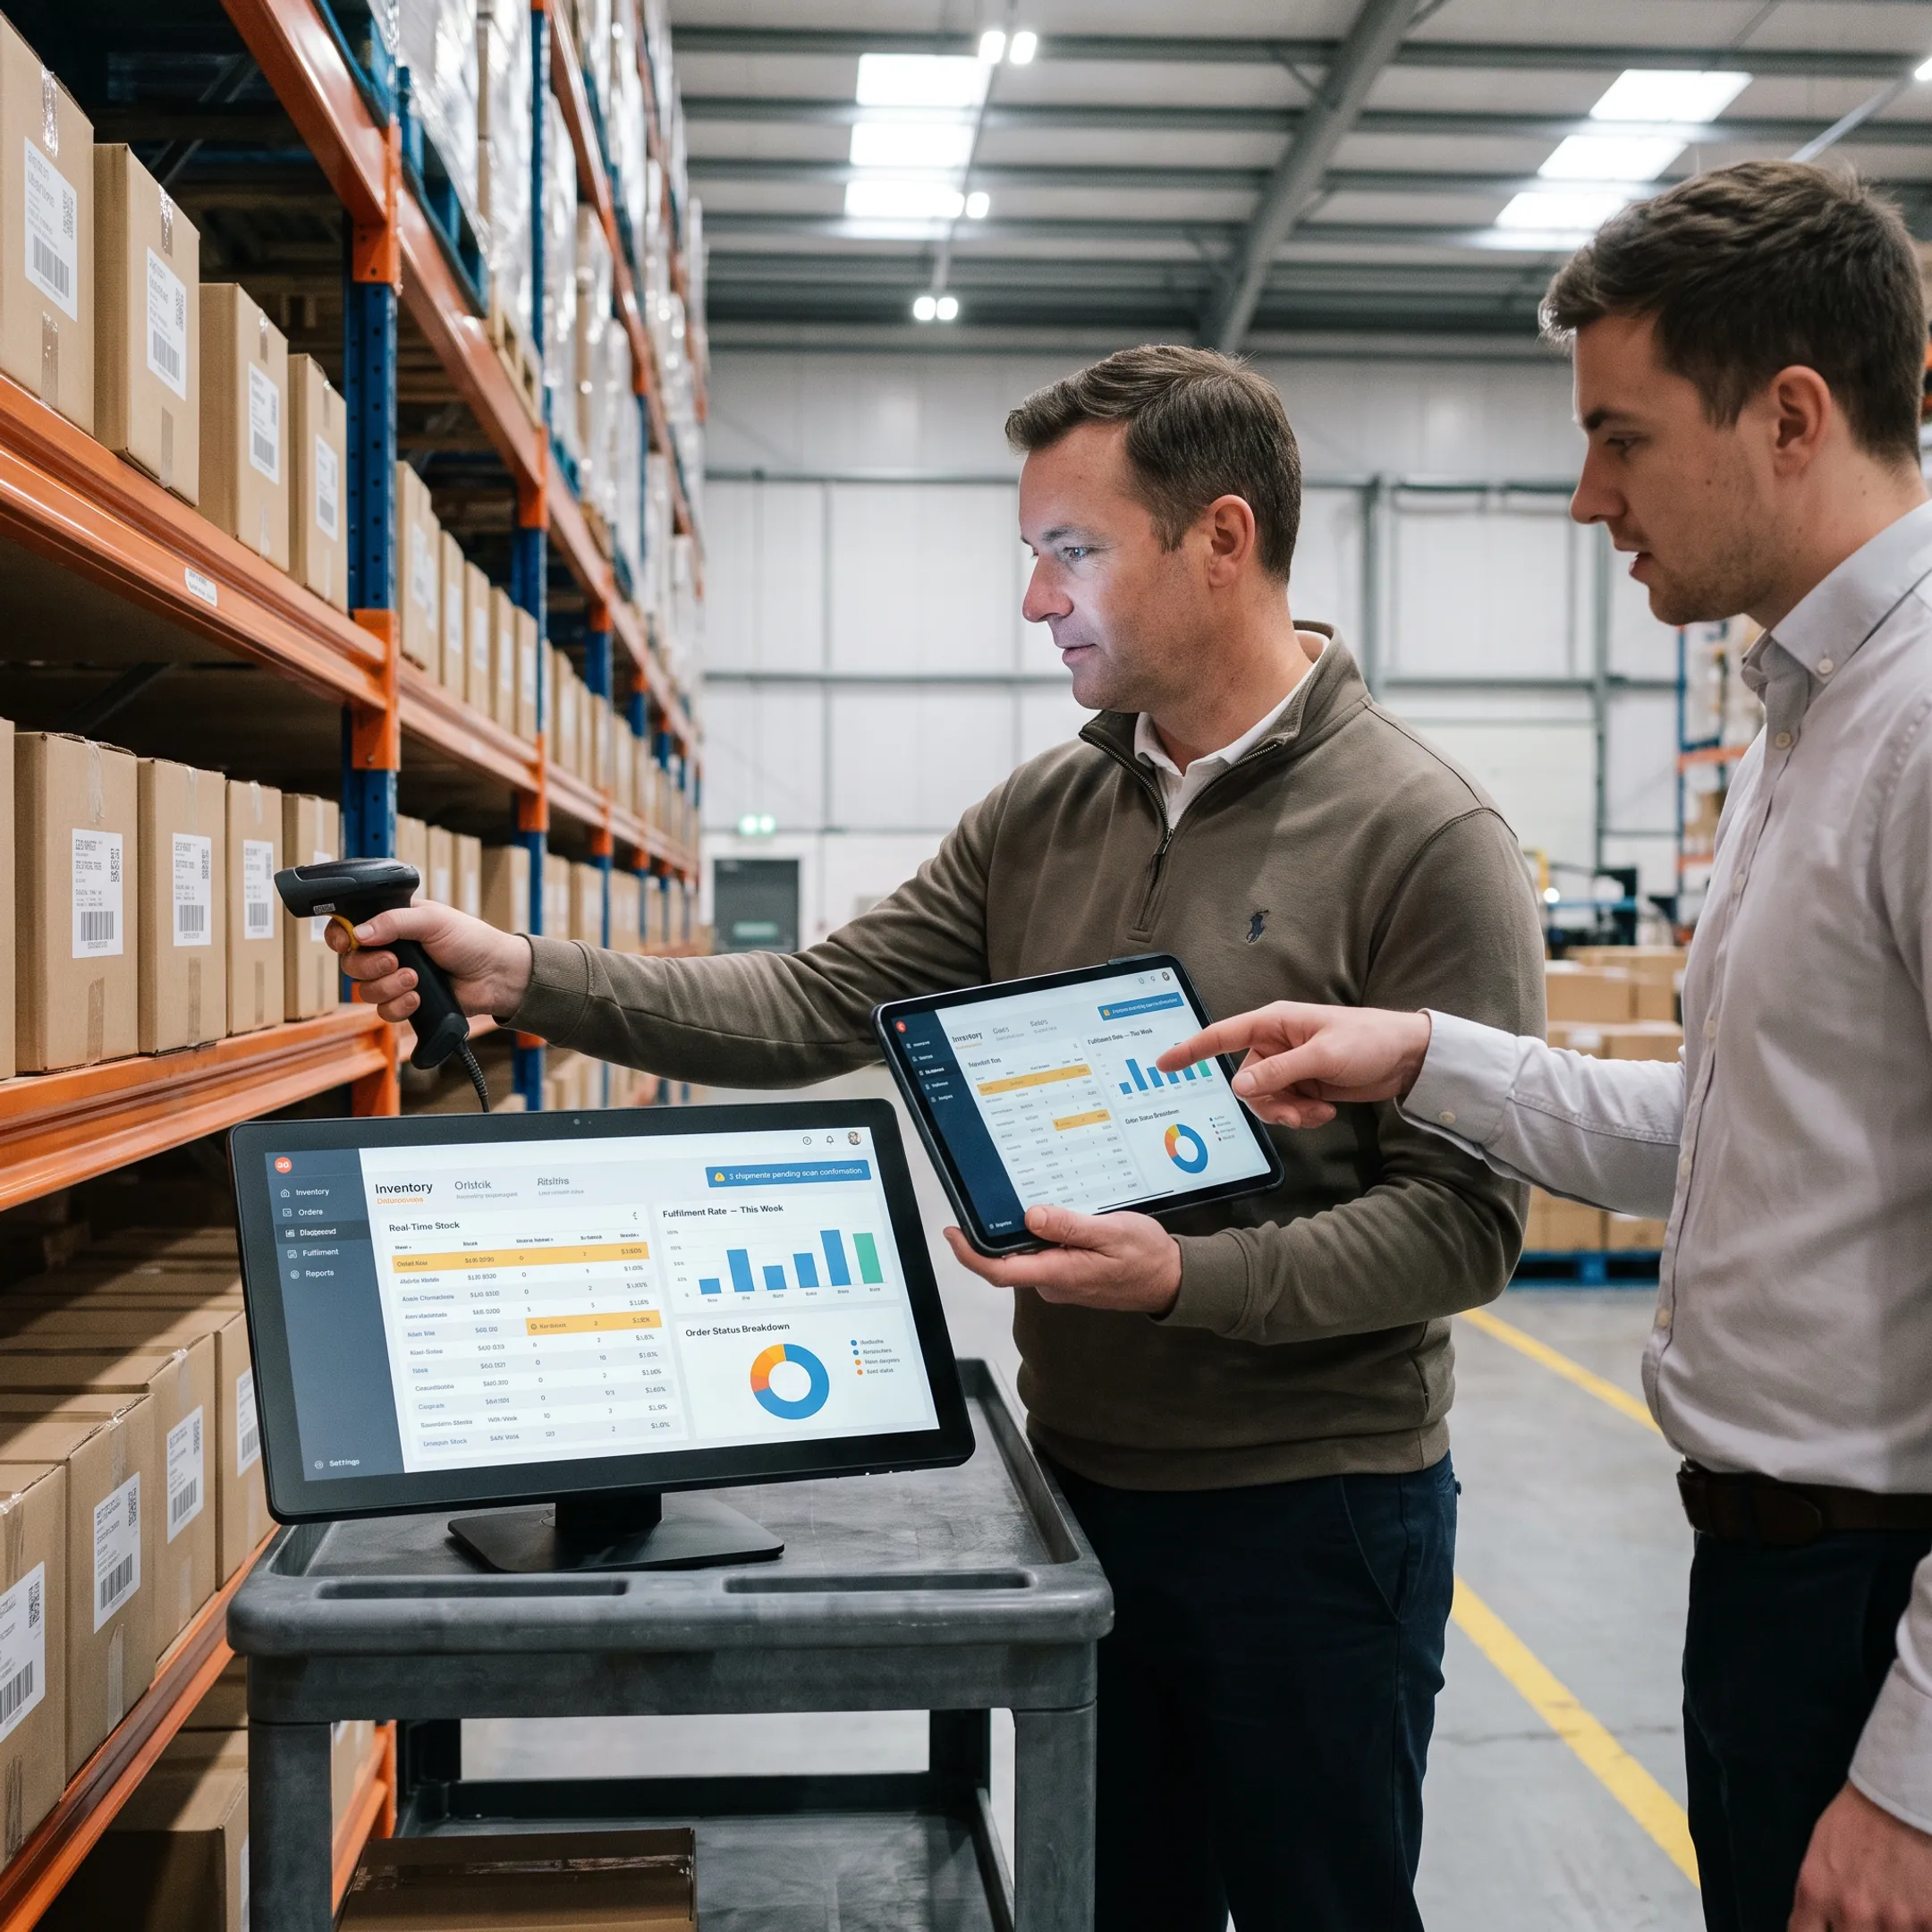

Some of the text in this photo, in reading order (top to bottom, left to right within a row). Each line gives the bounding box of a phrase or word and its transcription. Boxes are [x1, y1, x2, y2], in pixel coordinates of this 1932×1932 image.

[296, 1189, 330, 1197] Inventory
[375, 1182, 434, 1194] Inventory
[663, 1208, 706, 1217] Fulfilment
[708, 1208, 727, 1216] Rate
[740, 1206, 758, 1214] This
[389, 1221, 460, 1232] Real-Time Stock
[685, 1324, 790, 1336] Order Status Breakdown
